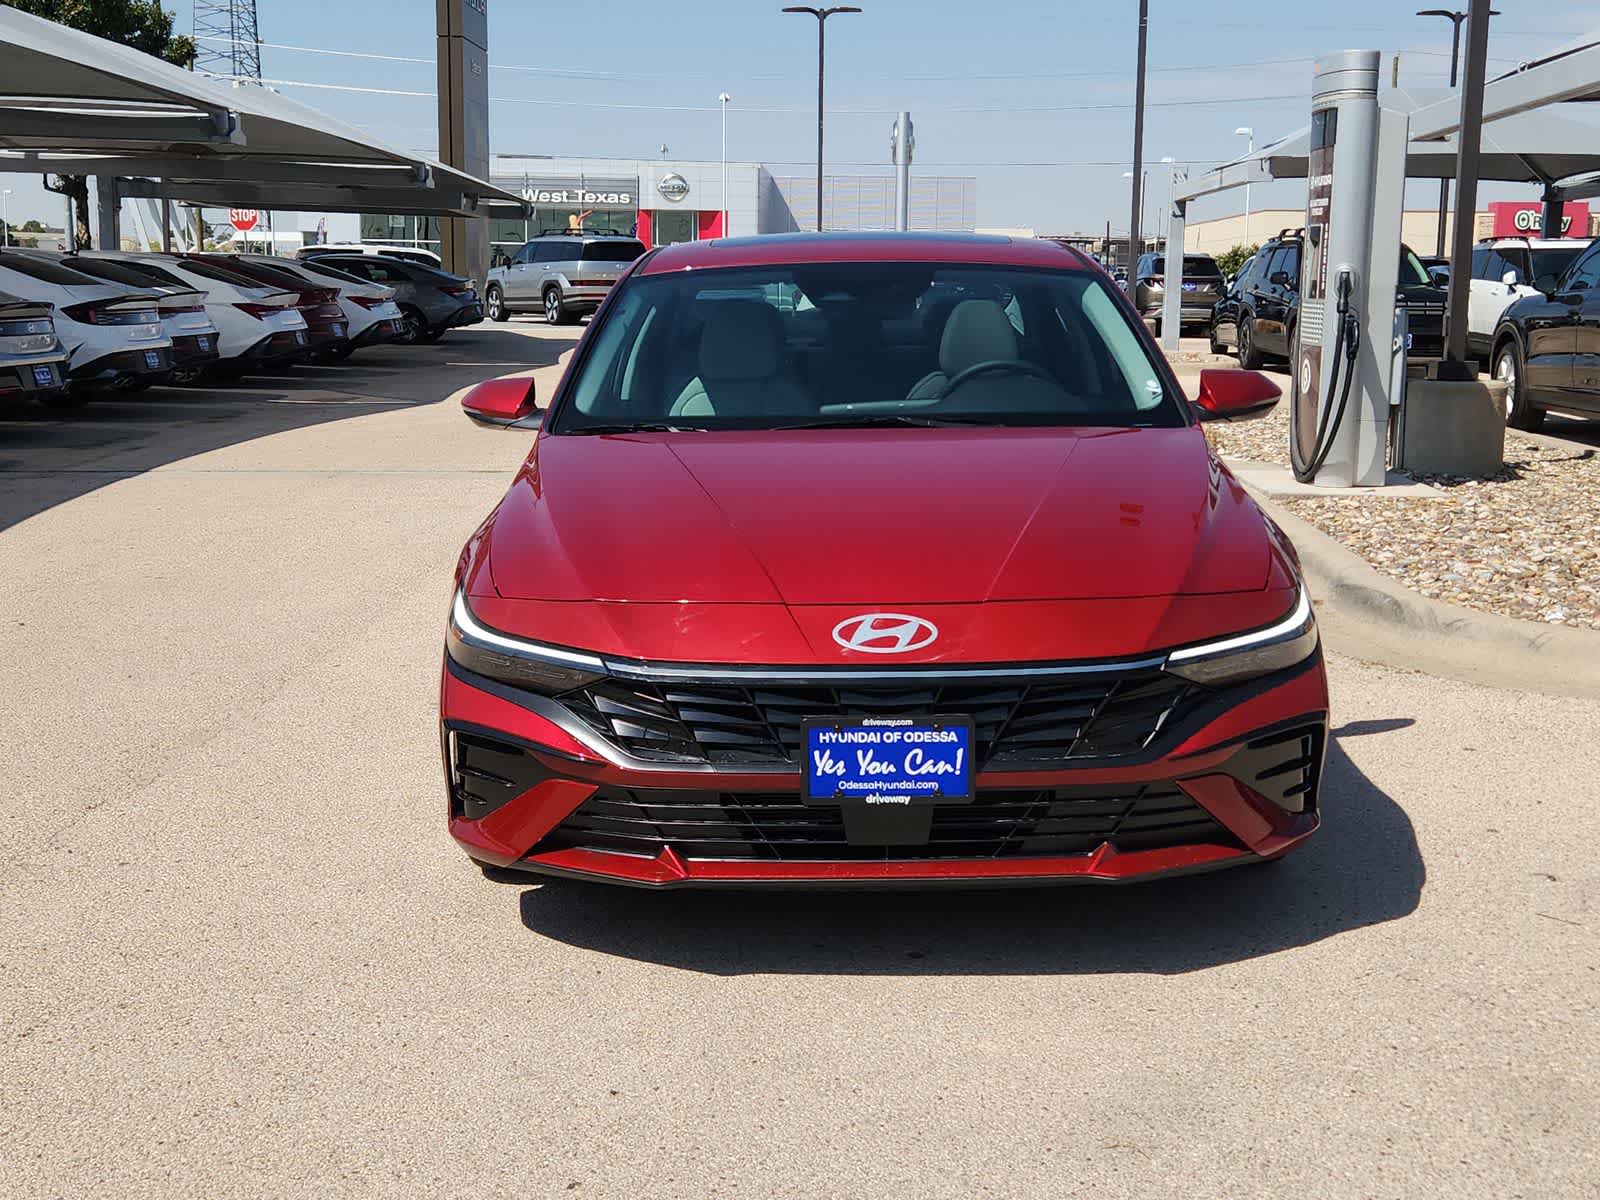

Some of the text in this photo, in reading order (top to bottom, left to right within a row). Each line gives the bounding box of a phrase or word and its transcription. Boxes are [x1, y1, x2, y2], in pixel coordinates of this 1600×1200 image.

[522, 189, 630, 203] West Texas
[231, 209, 256, 222] STOP
[862, 718, 913, 727] driveway.com
[819, 731, 958, 744] HYUNDAI OF ODESSA
[813, 747, 964, 776] Yes You Can!
[838, 780, 939, 791] OdessaHyundai.com
[865, 792, 912, 805] driveway
